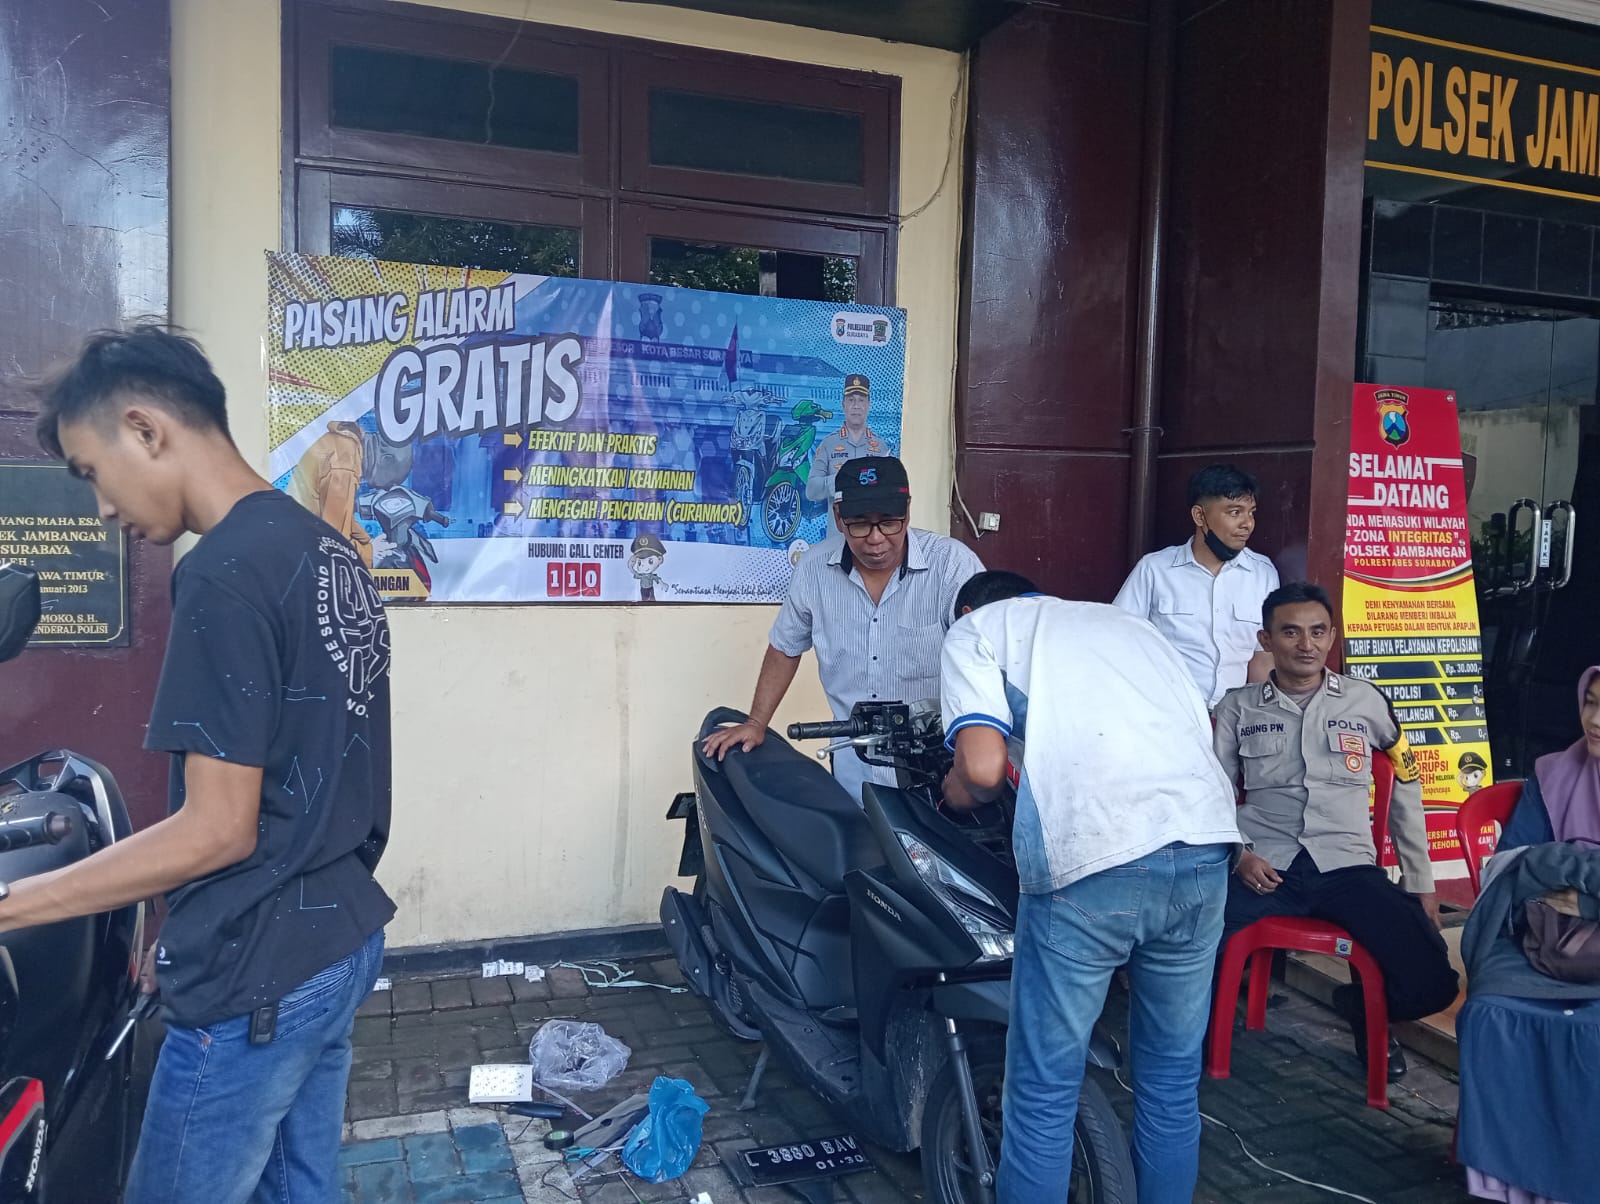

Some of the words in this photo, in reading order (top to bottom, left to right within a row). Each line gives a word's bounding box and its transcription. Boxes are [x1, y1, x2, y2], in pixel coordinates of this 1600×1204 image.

[1367, 51, 1519, 163] POLSEK
[1525, 83, 1600, 177] JAM
[284, 295, 408, 349] PASANG
[414, 283, 515, 338] ALARM
[377, 336, 584, 443] GRATIS
[527, 430, 576, 452] EFEKTIF
[577, 432, 607, 453] DAN
[606, 434, 658, 456] PRAKTIS
[1348, 452, 1435, 480] SELAMAT
[527, 464, 627, 489] MENINGKATKAN
[627, 469, 695, 492] KEAMANAN
[1372, 482, 1449, 509] DATANG
[527, 497, 598, 521] MENCEGAH
[599, 499, 665, 522] PENCURIAN
[665, 498, 743, 527] (CURANMOR)
[0, 516, 35, 526] YANG
[36, 516, 75, 526] MAHA
[78, 517, 103, 526] ESA
[1346, 514, 1365, 527] NDA
[1367, 514, 1421, 529] MEMASUKI
[1422, 516, 1466, 529] WILAYAH
[0, 530, 18, 541] EK
[21, 531, 107, 541] JAMBANGAN
[1353, 529, 1386, 543] ZONA
[1388, 530, 1453, 544] INTEGRITAS
[1, 544, 72, 555] SURABAYA
[527, 542, 567, 559] HUBUNGI
[568, 543, 590, 559] CALL
[592, 544, 625, 560] CENTER
[1393, 545, 1467, 558] JAMBANGAN
[1354, 557, 1413, 567] POLRESTABES
[1414, 558, 1457, 568] SURABAYA
[63, 571, 105, 581] TIMUR
[548, 568, 599, 590] 110
[68, 584, 88, 593] 2013
[374, 575, 410, 592] ANGAN
[1365, 600, 1381, 609] DEMI
[1382, 600, 1425, 609] KENYAMANAN
[1426, 600, 1456, 609] BERSAMA
[40, 614, 76, 623] MOKO,
[77, 614, 99, 623] S.H.
[1366, 611, 1399, 620] DILARANG
[1400, 611, 1428, 620] MEMBERI
[1429, 610, 1457, 620] IMBALAN
[34, 625, 77, 634] NDERAL
[77, 625, 108, 634] POLISI
[1347, 623, 1373, 632] KEPADA
[1374, 623, 1403, 632] PETUGAS
[1404, 622, 1425, 631] DALAM
[1426, 622, 1451, 631] BENTUK
[1349, 640, 1371, 656] TARIF
[1372, 639, 1394, 655] BIAYA
[1394, 638, 1437, 655] PELAYANAN
[1437, 637, 1478, 653] KEPOLISIAN
[1350, 664, 1379, 679] SKCK
[1445, 663, 1457, 676] Rp.
[1394, 685, 1422, 700] POLISI
[1446, 685, 1457, 697] Rp.
[1394, 707, 1435, 721] EHILANGAN
[1448, 707, 1459, 718] Rp.
[1240, 723, 1268, 737] AGUNG
[1269, 723, 1285, 733] PW
[1327, 719, 1368, 735] POLRI
[1450, 731, 1462, 742] Rp.
[1414, 749, 1440, 762] RITAS
[1418, 760, 1449, 774] RUPSI
[1420, 773, 1436, 785] SIH
[1427, 831, 1447, 840] ERSIH
[866, 888, 902, 922] HONDA
